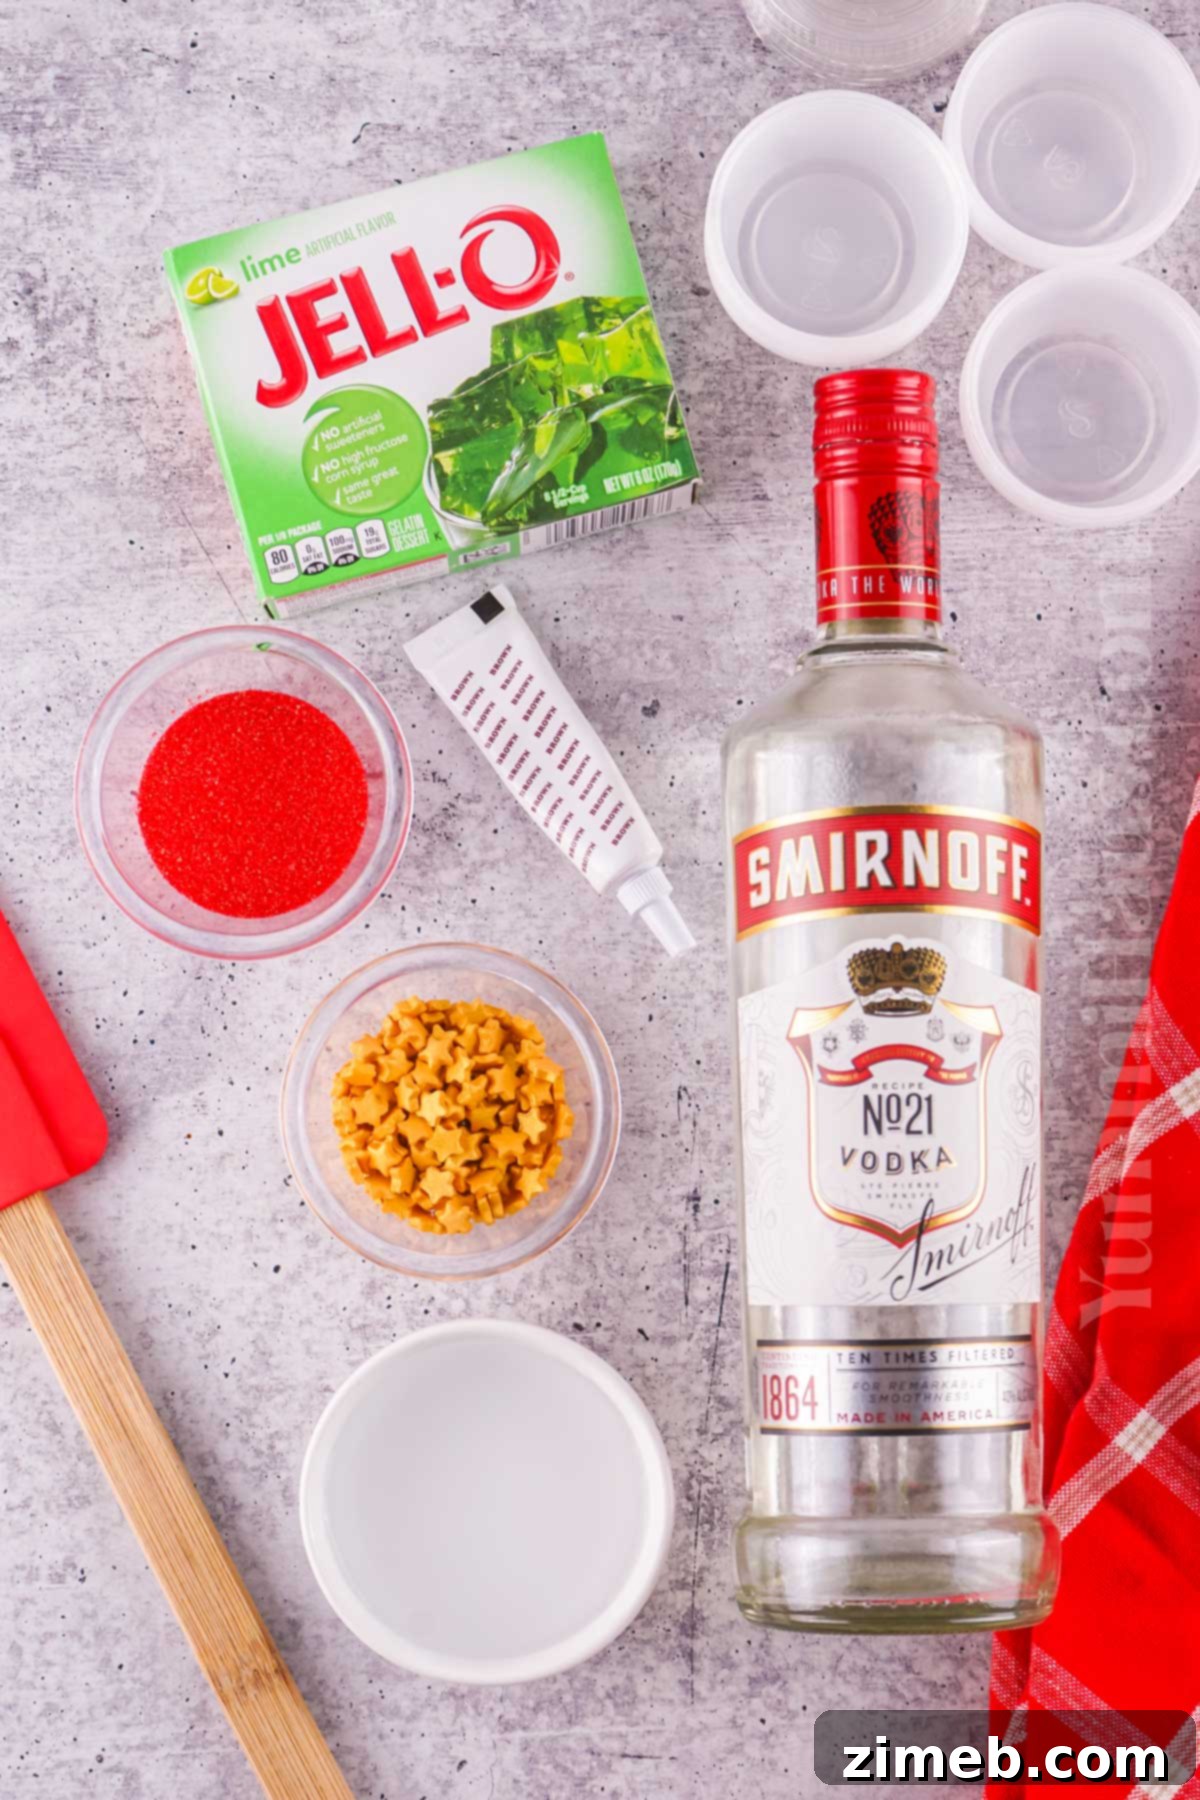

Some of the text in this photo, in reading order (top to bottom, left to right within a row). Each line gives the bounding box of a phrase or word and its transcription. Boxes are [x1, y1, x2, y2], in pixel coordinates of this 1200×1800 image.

[240, 211, 397, 282] lime ARTIFICIAL FLAVOR
[320, 410, 383, 441] NO artificial
[325, 423, 385, 452] sweeteners
[320, 434, 409, 473] NO high fructose
[326, 457, 379, 483] corn syrup
[343, 466, 399, 494] same great
[346, 488, 373, 505] taste
[271, 549, 289, 565] 80
[816, 575, 939, 598] KA THE WOR
[489, 644, 512, 676] BROWN
[500, 659, 523, 691] BROWN
[450, 670, 474, 701] BROWN
[511, 674, 534, 705] BROWN
[462, 687, 485, 717] BROWN
[522, 690, 546, 722] BROWN
[534, 706, 557, 738] BROWN
[496, 733, 518, 765] BROWN
[545, 722, 568, 755] BROWN
[508, 749, 530, 781] BROWN
[557, 739, 580, 771] BROWN
[568, 755, 591, 786] BROWN
[579, 770, 602, 801] BROWN
[589, 785, 613, 816] BROWN
[600, 801, 624, 831] BROWN
[611, 817, 635, 846] BROWN
[872, 1082, 924, 1090] RECIPE
[840, 1145, 956, 1175] VODKA
[837, 1348, 1014, 1364] TEN TIMES FILTERED
[761, 1374, 818, 1421] 1864
[853, 1379, 984, 1391] FOR REMARKABLE
[869, 1391, 969, 1404] SMOOTHNESS
[837, 1409, 993, 1424] MADE IN AMERICA
